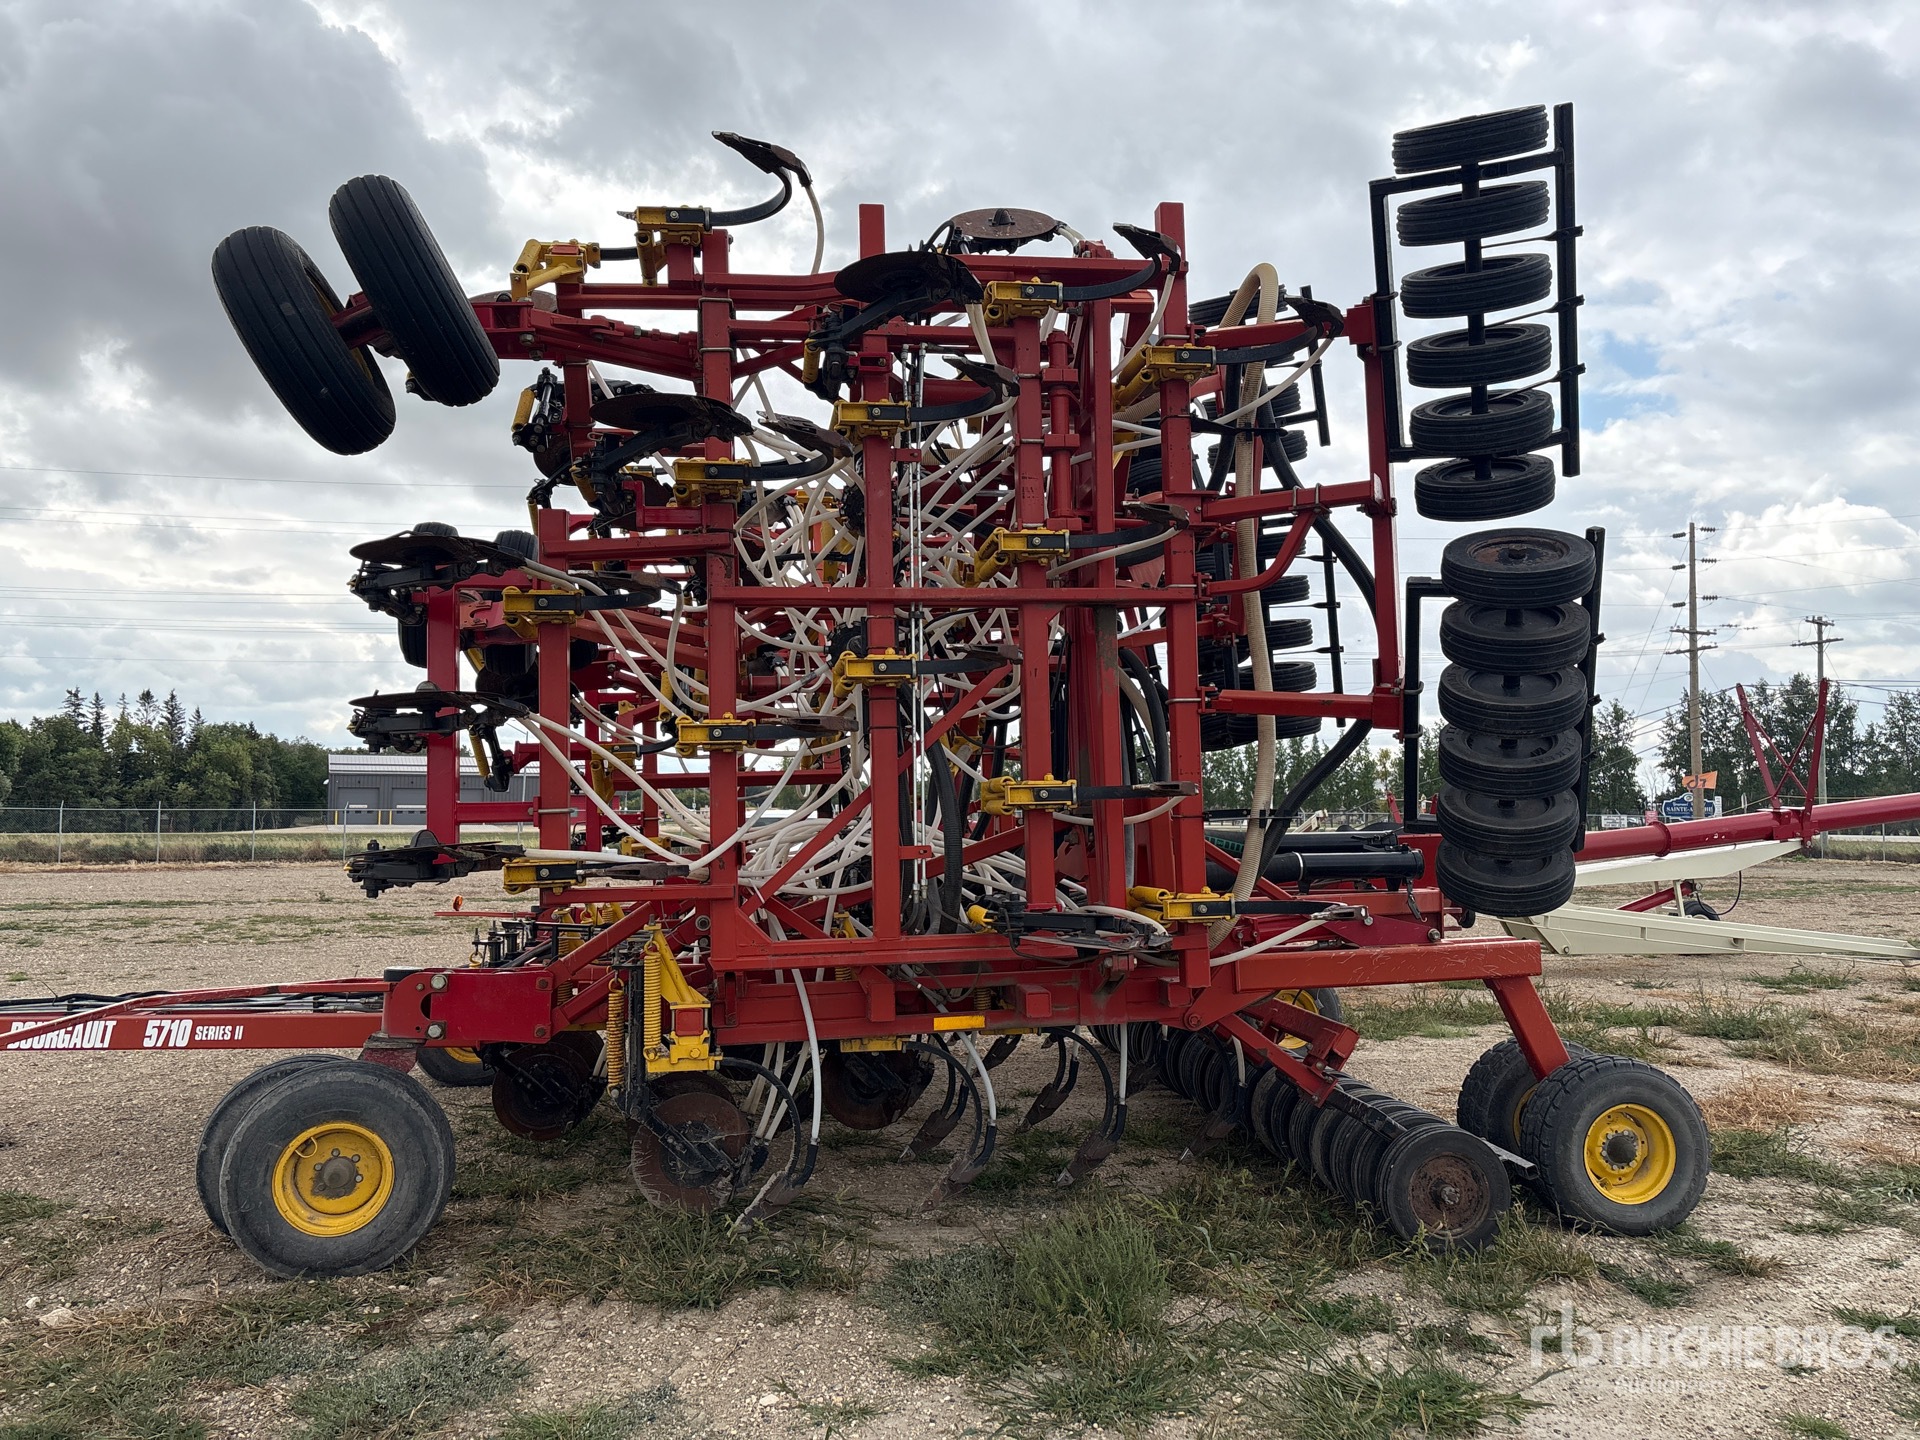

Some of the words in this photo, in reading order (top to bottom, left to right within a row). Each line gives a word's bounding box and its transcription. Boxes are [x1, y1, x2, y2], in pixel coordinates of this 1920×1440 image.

[142, 1018, 193, 1048] 5710
[194, 1025, 233, 1041] SERIES
[234, 1025, 244, 1040] II
